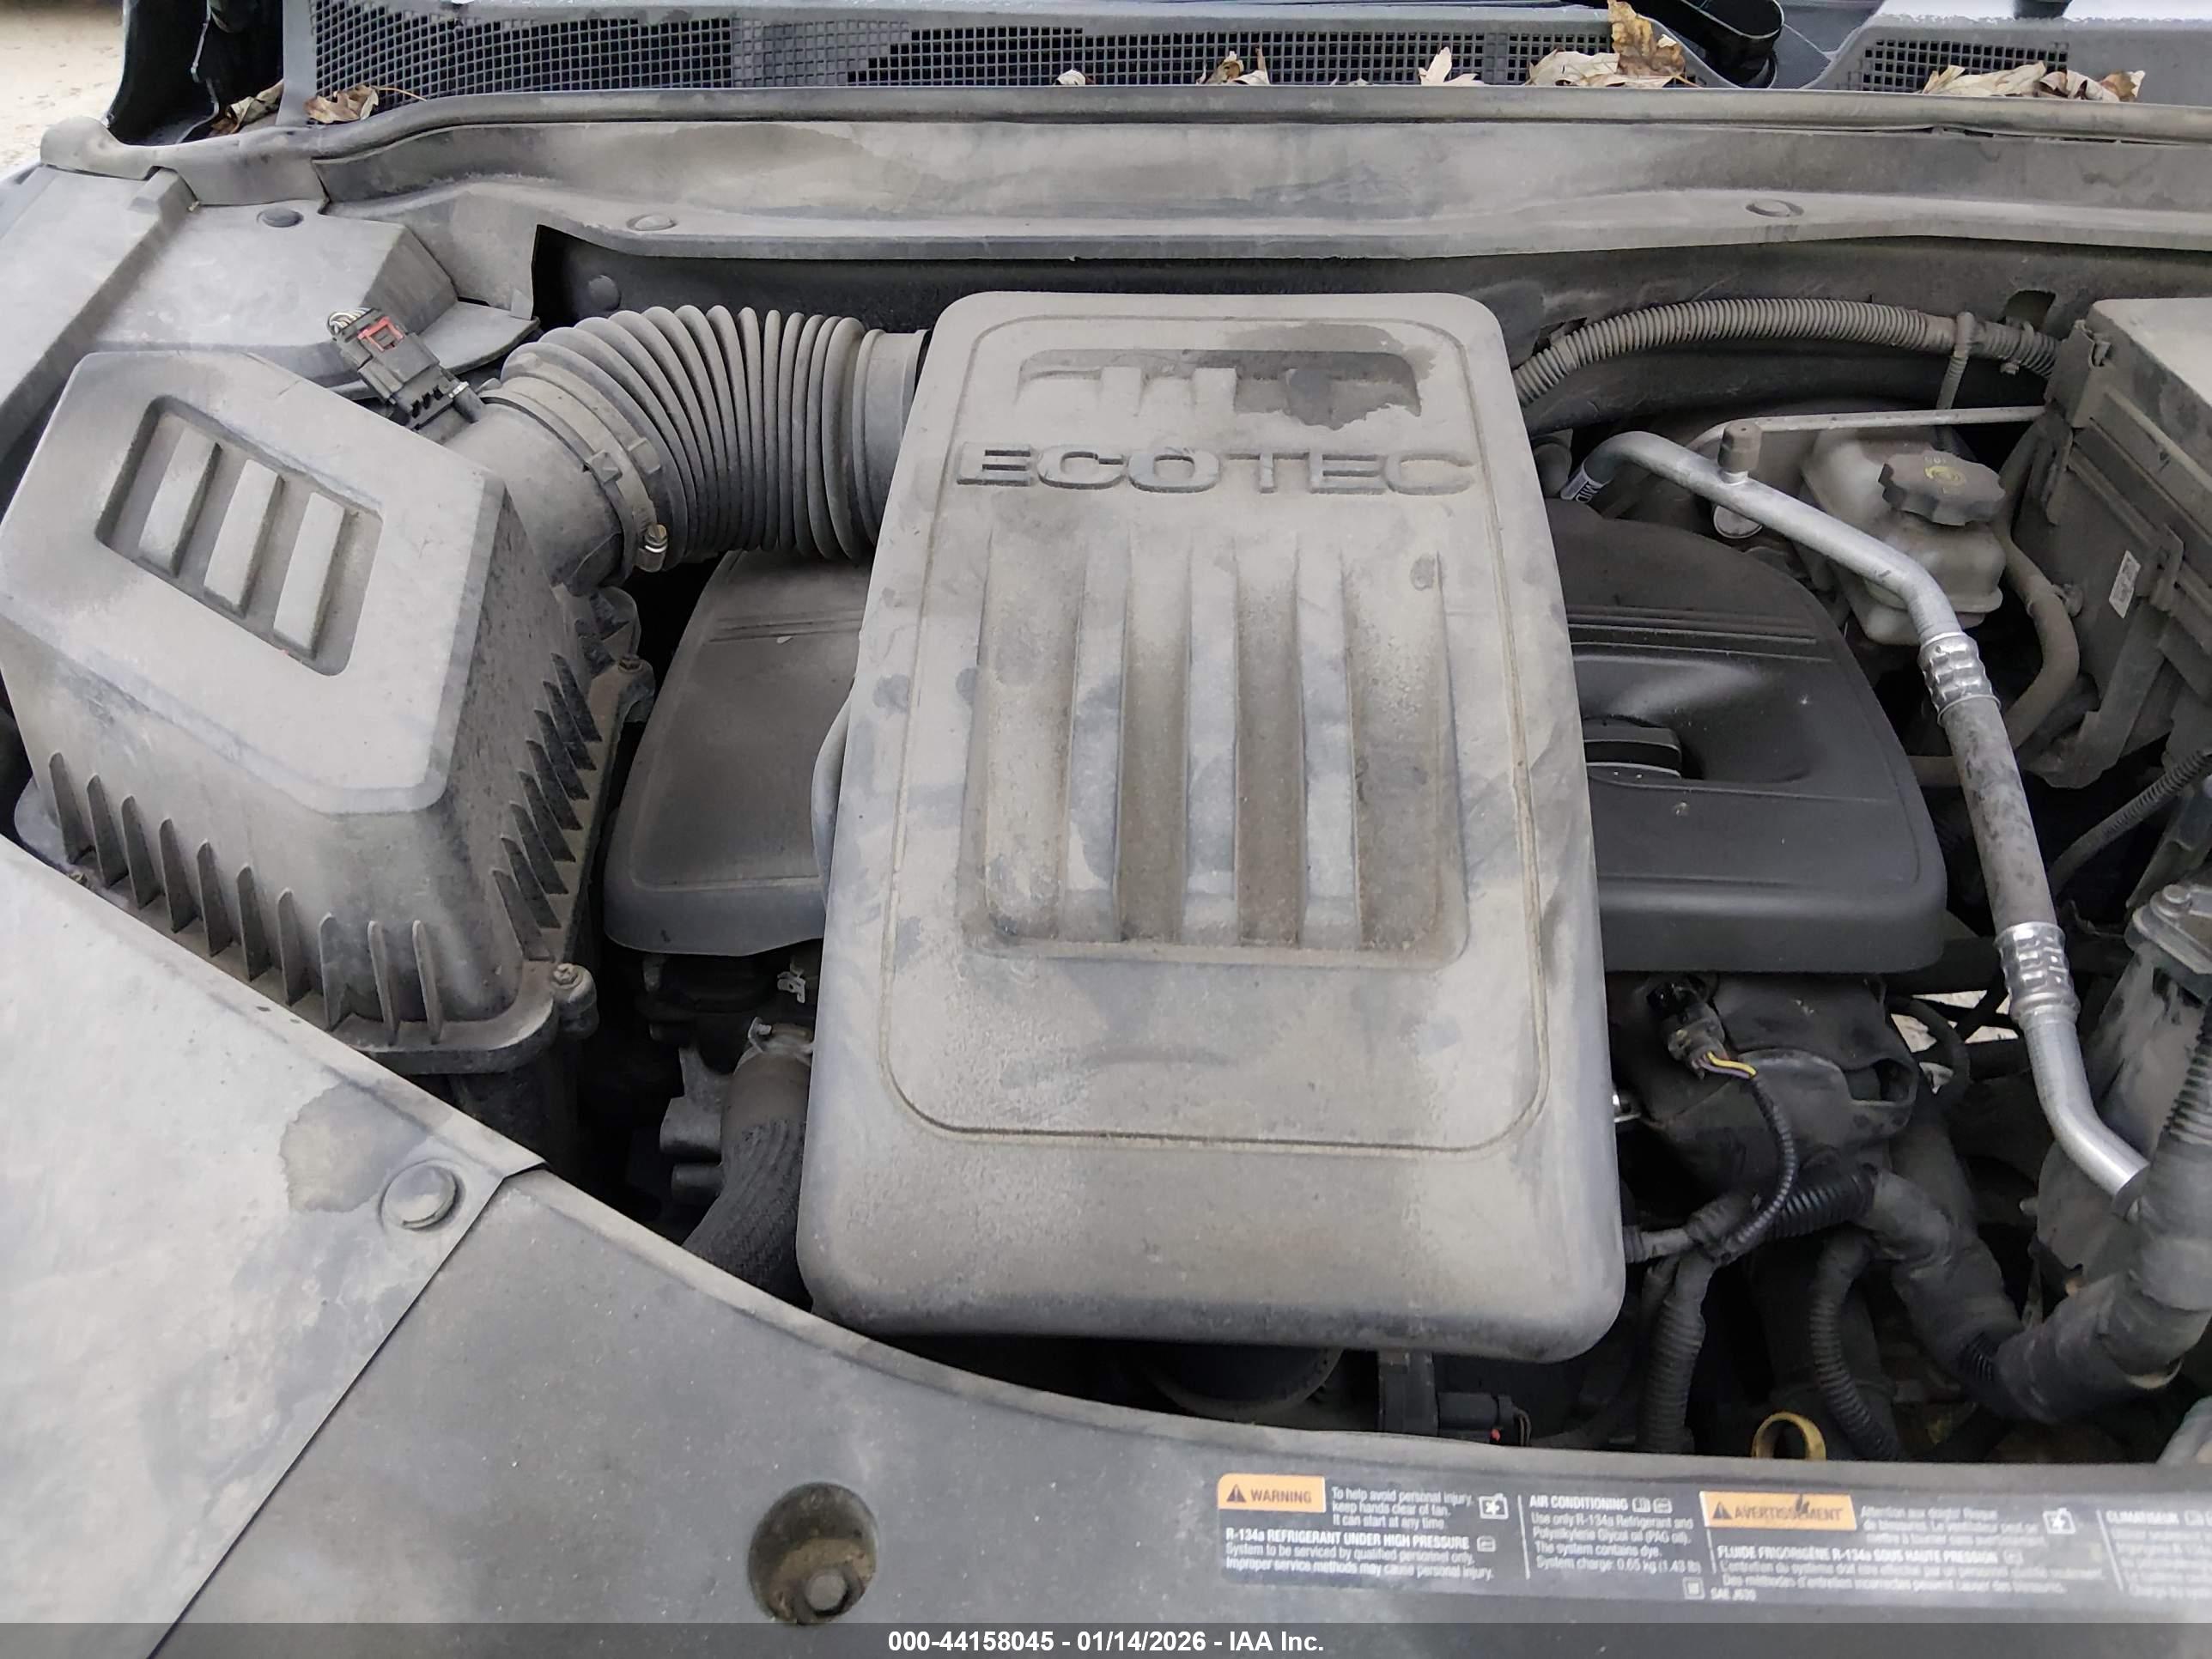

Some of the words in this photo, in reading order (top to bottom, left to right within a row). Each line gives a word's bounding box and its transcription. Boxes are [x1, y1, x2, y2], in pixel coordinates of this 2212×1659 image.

[957, 444, 1474, 495] ECOTEC
[1250, 1488, 1312, 1504] WARNING
[1332, 1486, 1344, 1498] To
[1346, 1487, 1368, 1502] help
[1370, 1489, 1396, 1503] avoid
[1399, 1491, 1442, 1505] personal
[1529, 1495, 1548, 1509] AIR
[1551, 1496, 1629, 1510] CONDITIONING
[1332, 1500, 1357, 1514] keep
[1359, 1502, 1390, 1515] hands
[1392, 1504, 1417, 1516] clear
[1419, 1504, 1430, 1516] of
[1735, 1505, 1843, 1521] AVERTISSEMENT
[1333, 1513, 1340, 1526] It
[1342, 1516, 1360, 1527] can
[1363, 1515, 1387, 1528] start
[1389, 1516, 1399, 1528] at
[1401, 1517, 1419, 1531] any
[1531, 1511, 1551, 1525] Use
[1553, 1513, 1574, 1528] only
[1576, 1513, 1614, 1527] R-134a
[1674, 1518, 1693, 1530] and
[1225, 1527, 1265, 1541] R-134a
[1267, 1528, 1341, 1544] REFRIGERANT
[1343, 1532, 1381, 1546] UNDER
[1383, 1534, 1411, 1547] HIGH
[1413, 1535, 1470, 1550] PRESSURE
[1645, 1530, 1669, 1544] (PAG
[1225, 1541, 1264, 1557] System
[1266, 1543, 1277, 1557] to
[1279, 1543, 1291, 1557] be
[1294, 1545, 1337, 1559] serviced
[1339, 1547, 1352, 1561] by
[1353, 1548, 1397, 1562] qualified
[1535, 1540, 1554, 1554] The
[1556, 1543, 1593, 1557] system
[1595, 1544, 1639, 1557] contains
[1717, 1546, 1756, 1559] FLUIDE
[1226, 1557, 1272, 1572] Improper
[1274, 1559, 1311, 1572] service
[1313, 1561, 1358, 1574] methods
[1359, 1563, 1382, 1577] may
[1384, 1565, 1415, 1577] cause
[1417, 1565, 1461, 1579] personal
[1536, 1555, 1575, 1571] System
[1643, 1559, 1656, 1574] kg
[1711, 1587, 1731, 1600] SAE
